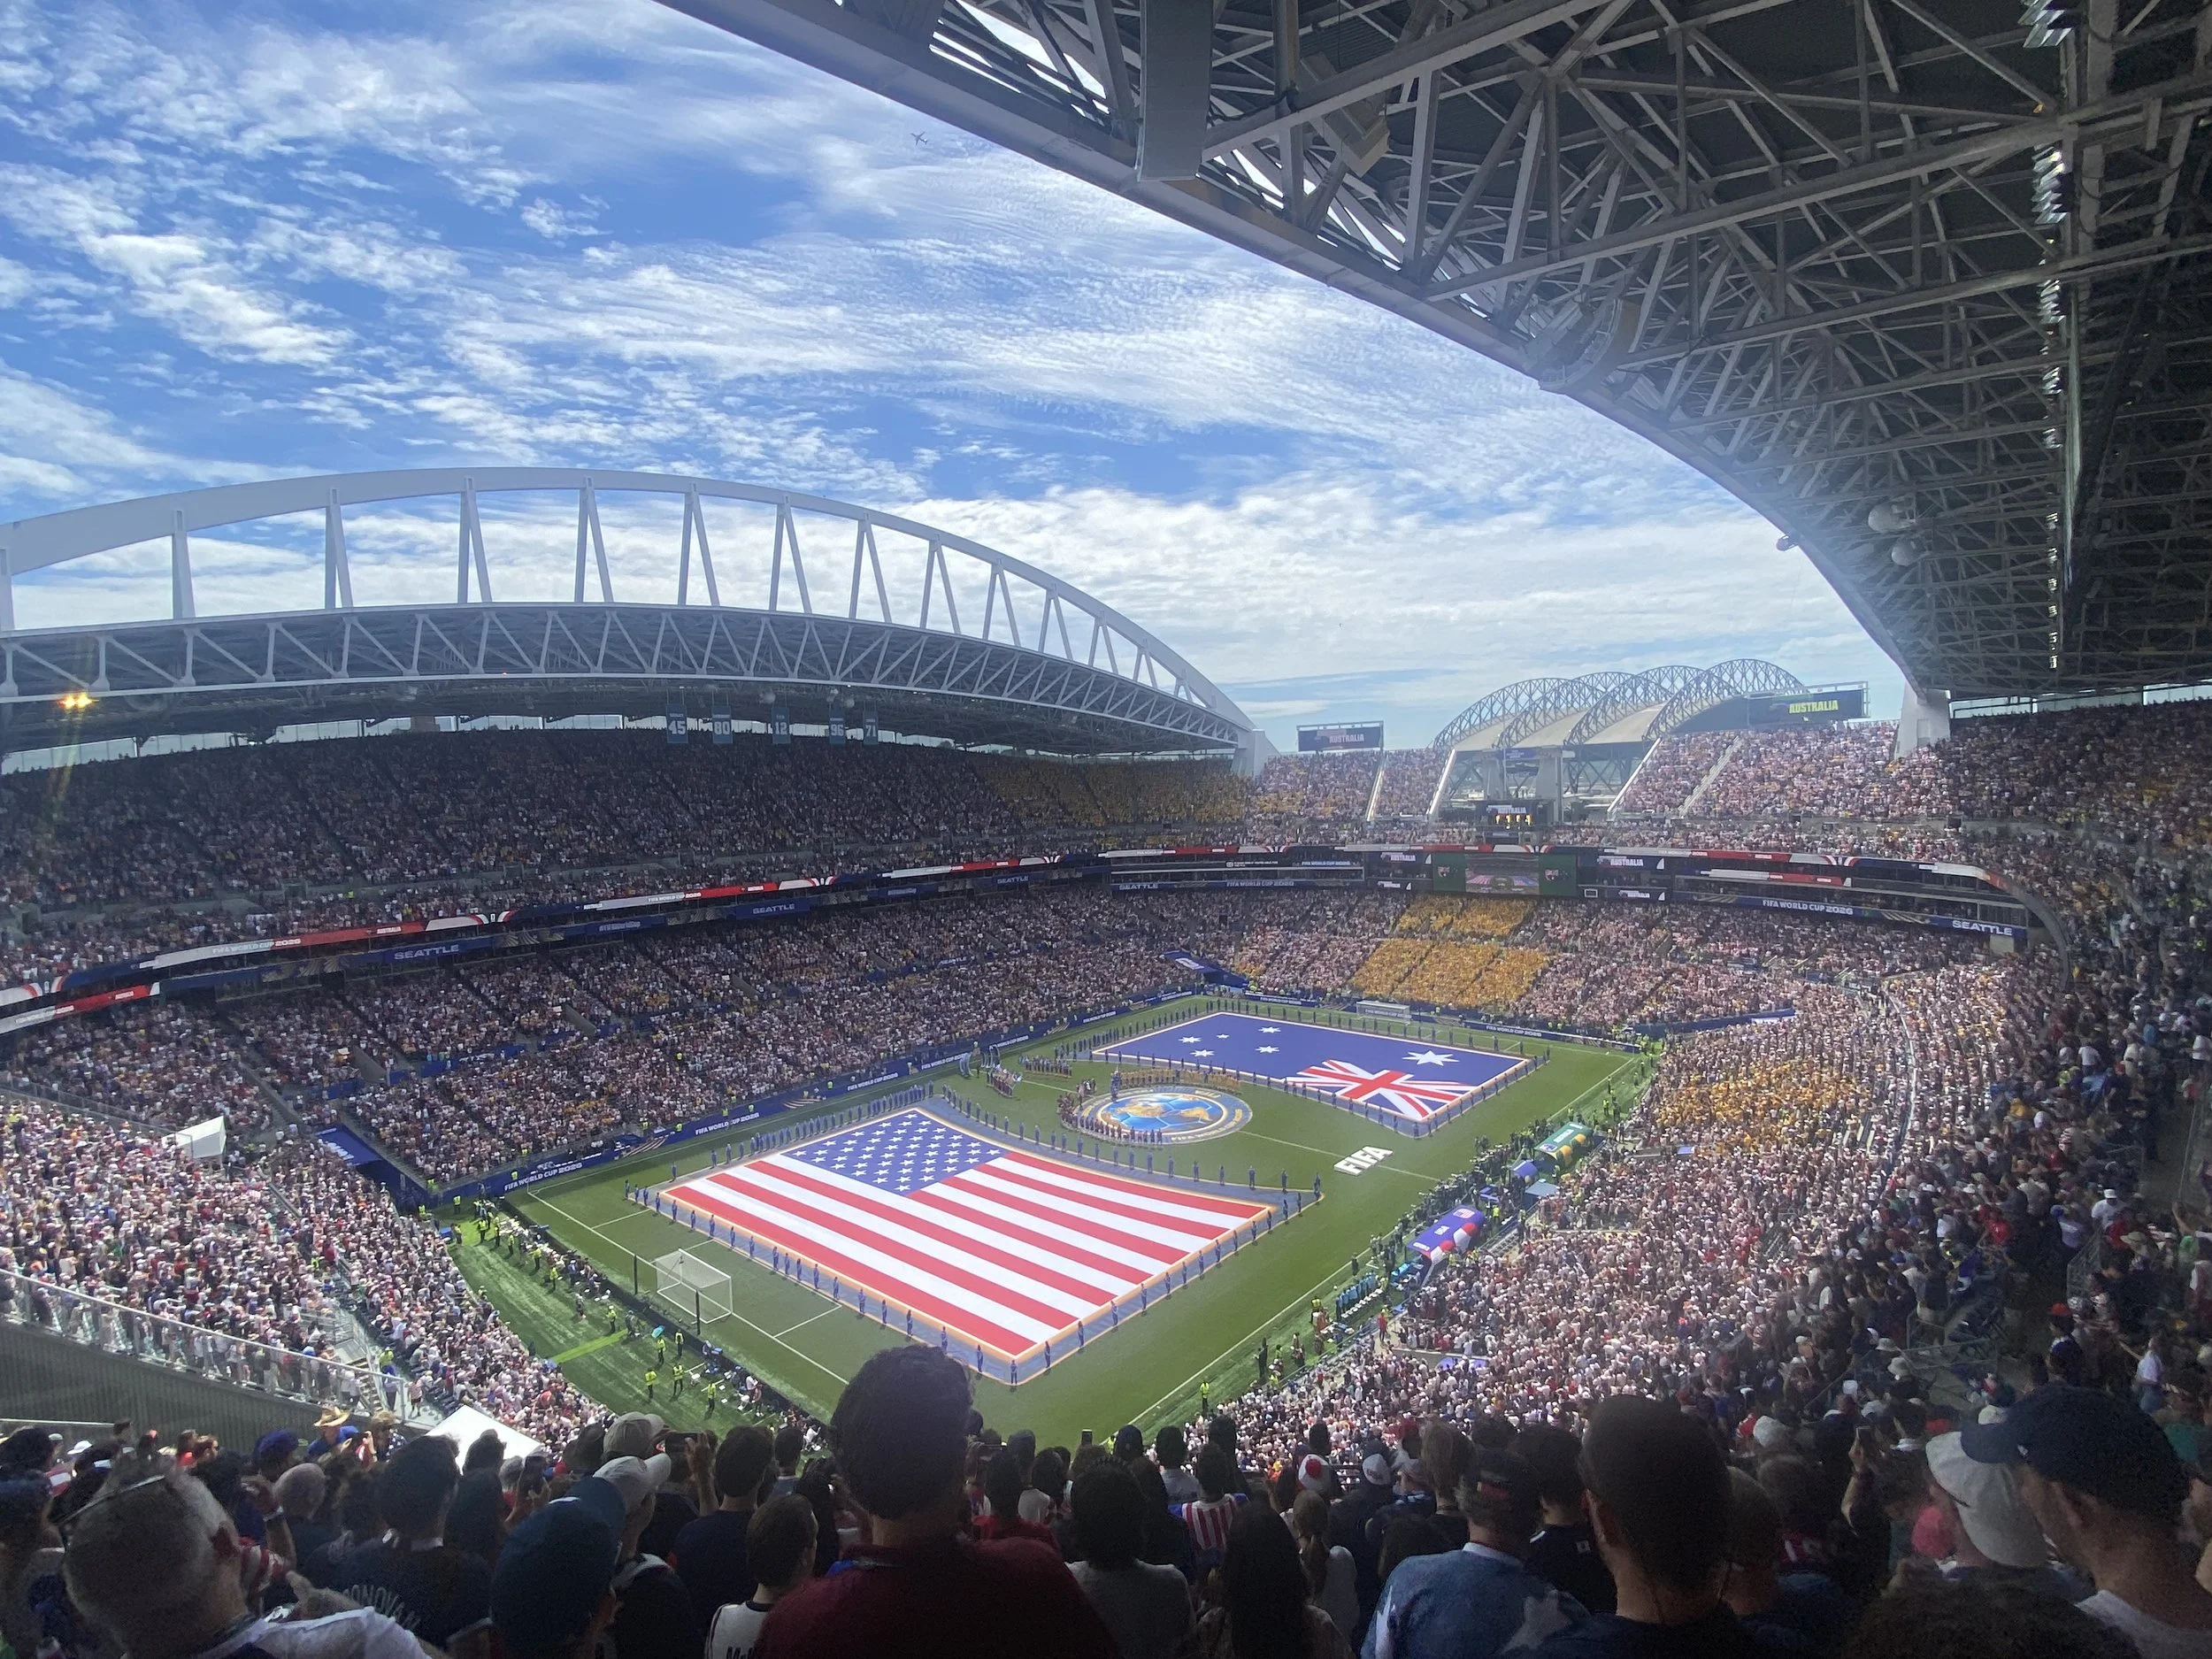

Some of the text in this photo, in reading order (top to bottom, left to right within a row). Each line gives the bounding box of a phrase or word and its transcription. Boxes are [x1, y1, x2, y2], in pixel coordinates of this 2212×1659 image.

[1788, 700, 1839, 714] AUSTRALIA
[668, 720, 686, 734] 45
[714, 721, 730, 735] 80
[775, 722, 787, 735] 12
[866, 726, 876, 737] 71
[1329, 733, 1364, 743] AUSTRALIA
[997, 875, 1029, 884] SEATTLE
[753, 903, 795, 914] SEATTLE
[1779, 902, 1808, 910] WORLD
[1825, 905, 1854, 915] 2026
[1952, 919, 2013, 936] SEATTLE
[231, 944, 258, 953] WORLD
[394, 944, 459, 960] SEATTLE
[858, 1079, 874, 1088] WORLD
[695, 1126, 708, 1135] FIFA
[708, 1122, 729, 1132] WORLD
[1334, 1146, 1394, 1176] FIFA
[504, 1181, 518, 1191] FIFA
[518, 1173, 543, 1186] WORLD
[558, 1162, 583, 1174] 2026
[342, 1584, 422, 1629] ONOVAN
